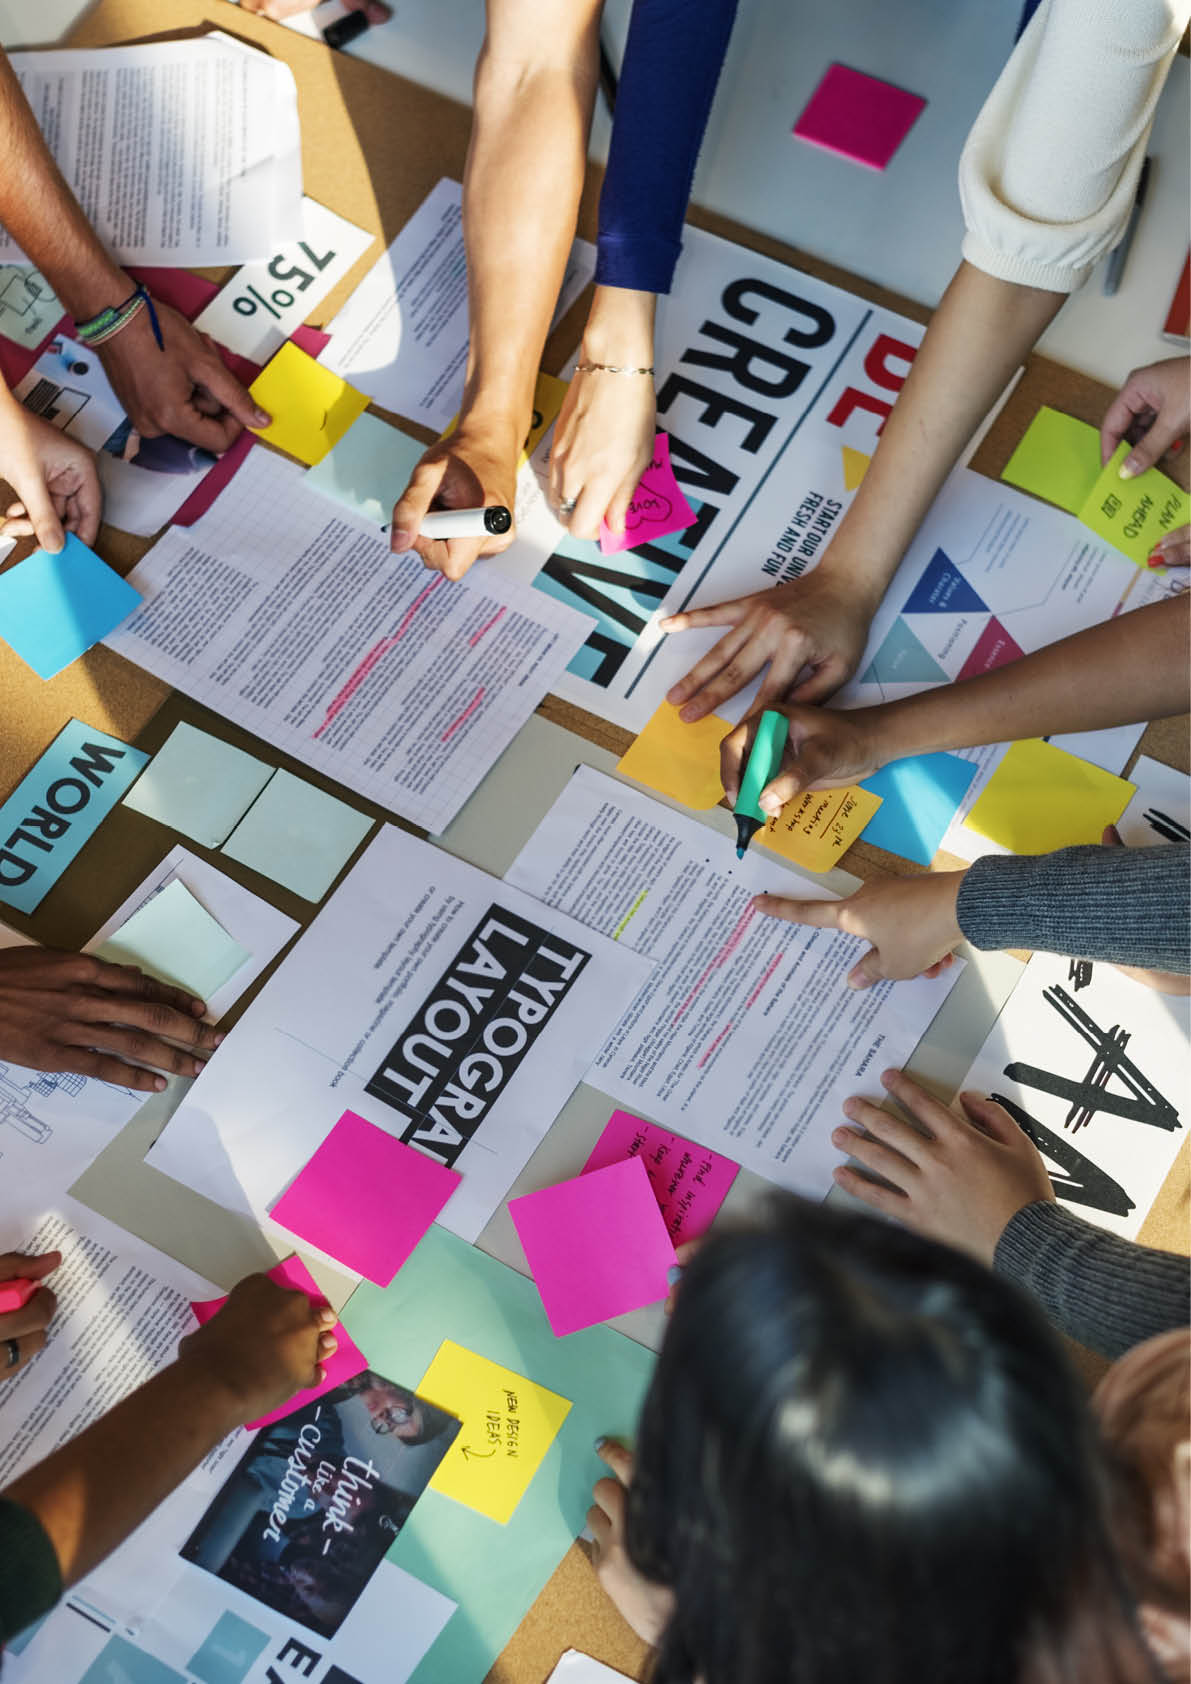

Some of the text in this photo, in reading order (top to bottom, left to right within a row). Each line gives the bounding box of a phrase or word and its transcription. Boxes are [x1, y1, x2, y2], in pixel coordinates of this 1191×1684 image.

[232, 242, 337, 321] 75%
[812, 500, 842, 535] START
[1124, 495, 1153, 538] AHEAD
[1159, 494, 1181, 529] PLAN
[762, 492, 823, 576] FRESH AND FUN
[798, 533, 822, 556] OUR
[0, 742, 126, 886] WORLD
[384, 918, 527, 1107] LAYOUT
[340, 1039, 366, 1071] collection
[854, 1034, 885, 1077] THE SAHARA
[329, 1070, 344, 1089] book
[486, 1410, 501, 1444] IDEAS
[506, 1418, 520, 1457] DESIGN
[264, 1424, 320, 1542] customer
[304, 1461, 335, 1510] like a
[323, 1456, 384, 1532] think
